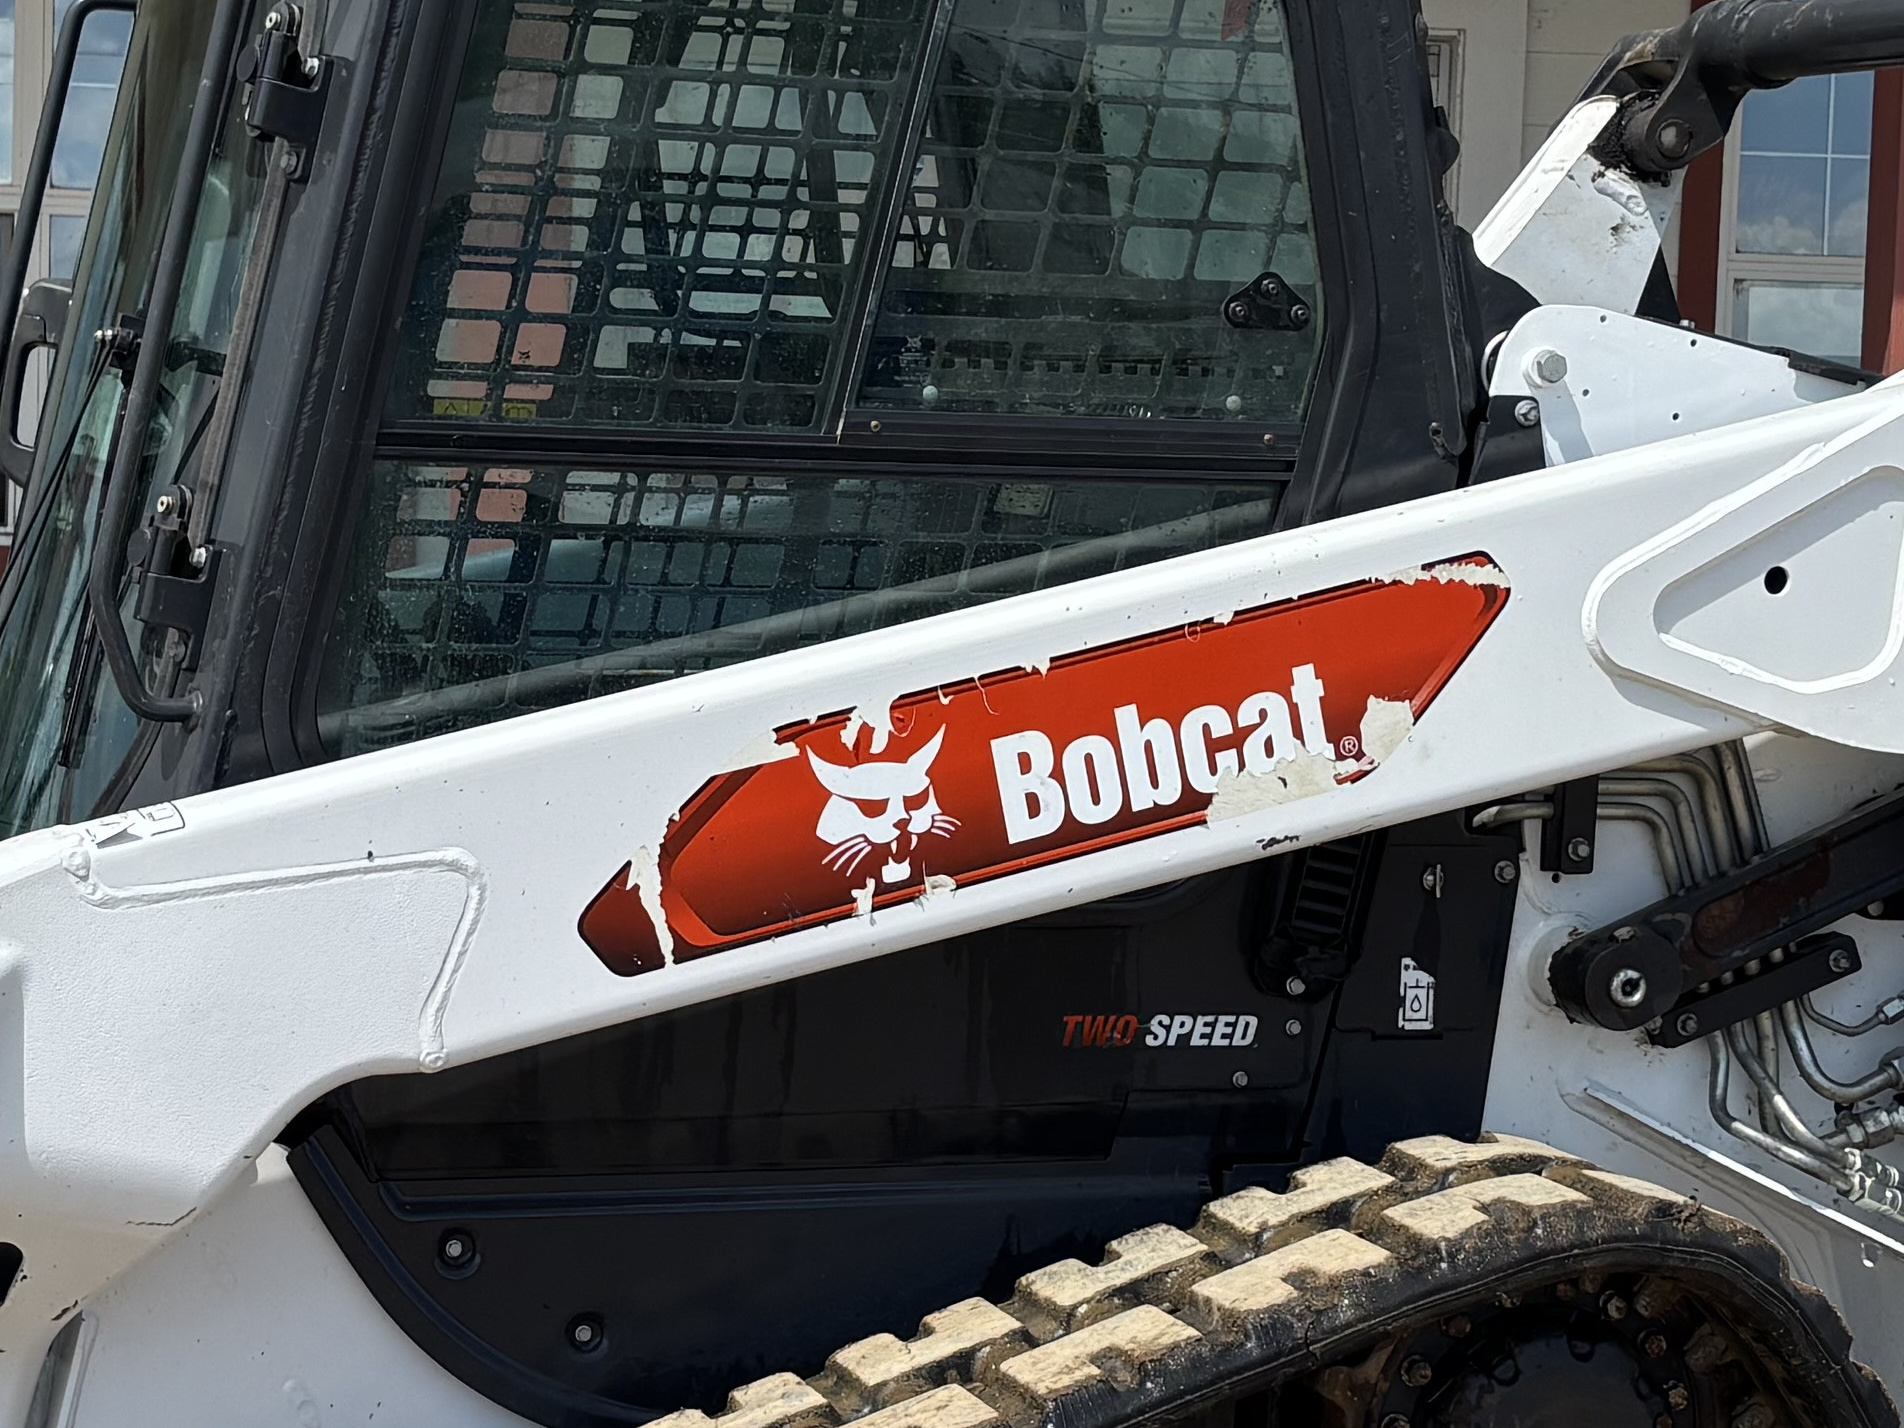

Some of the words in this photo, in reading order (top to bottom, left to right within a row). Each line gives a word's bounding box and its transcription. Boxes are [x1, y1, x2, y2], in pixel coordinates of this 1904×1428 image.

[989, 662, 1336, 846] Bobcat
[1062, 1014, 1139, 1048] TWO
[1145, 1014, 1259, 1047] SPEED
